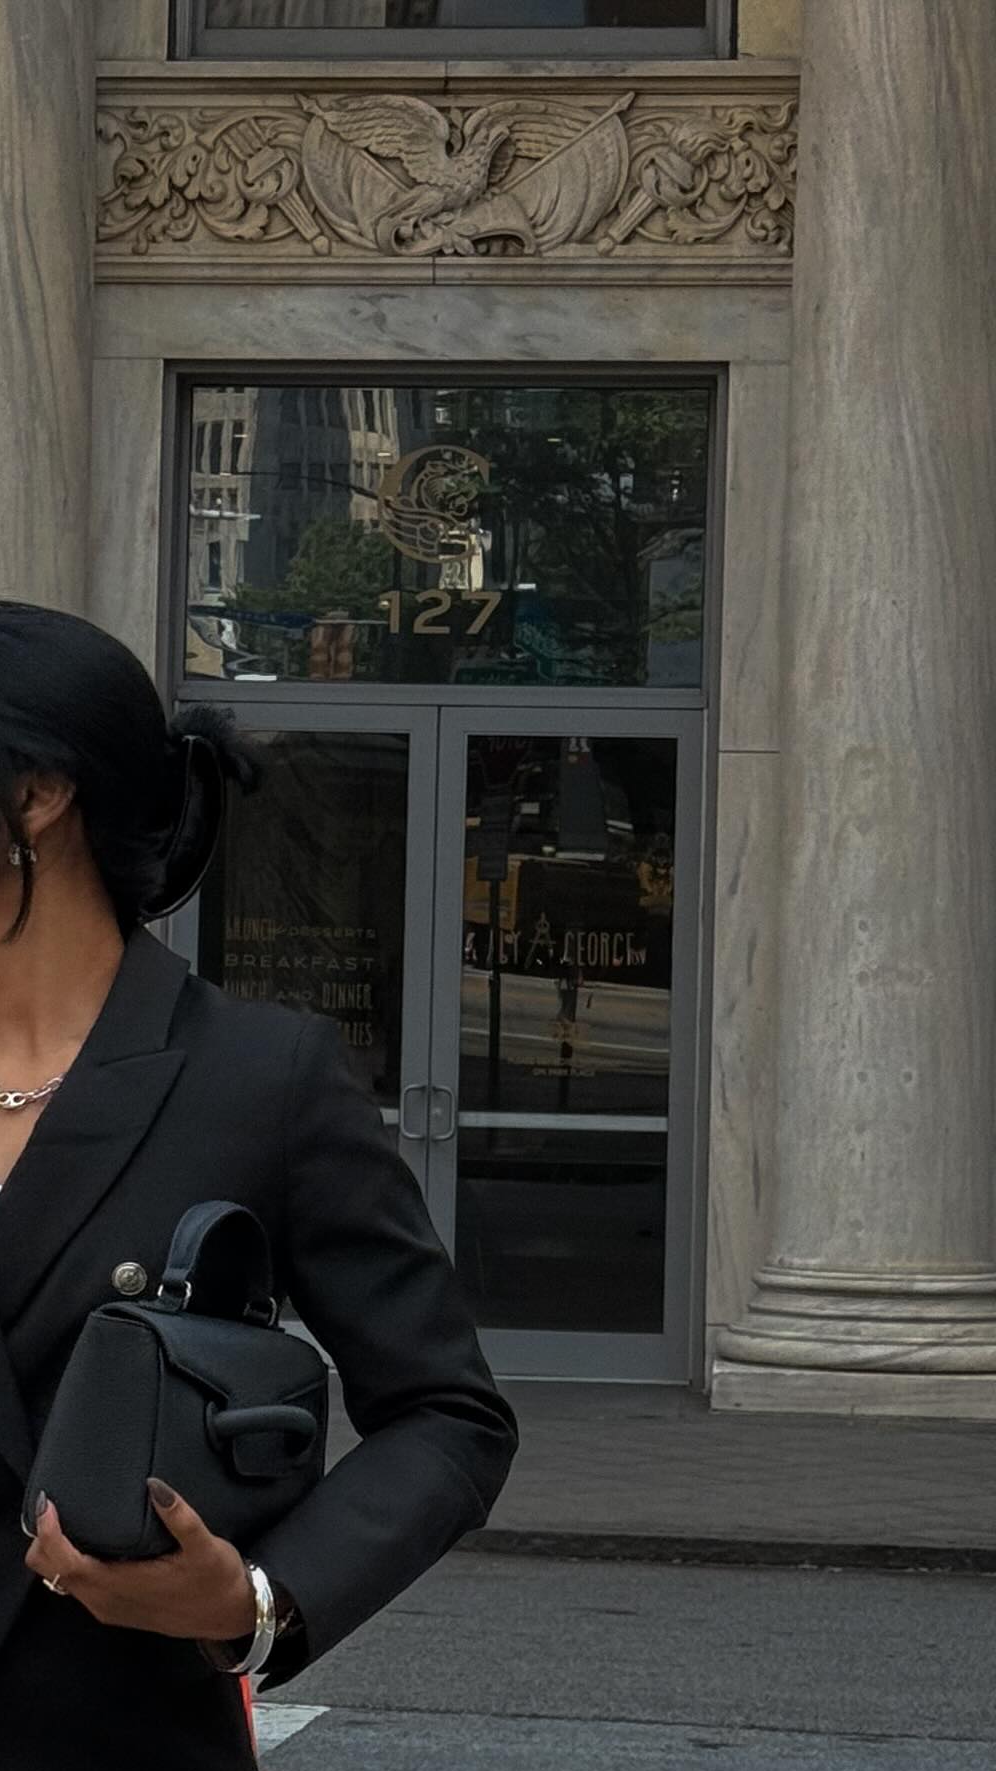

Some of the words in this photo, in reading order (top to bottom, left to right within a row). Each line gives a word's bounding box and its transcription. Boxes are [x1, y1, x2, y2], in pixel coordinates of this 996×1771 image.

[379, 589, 502, 634] 127
[224, 953, 375, 970] BREAKFAST
[322, 982, 372, 1010] DINNER
